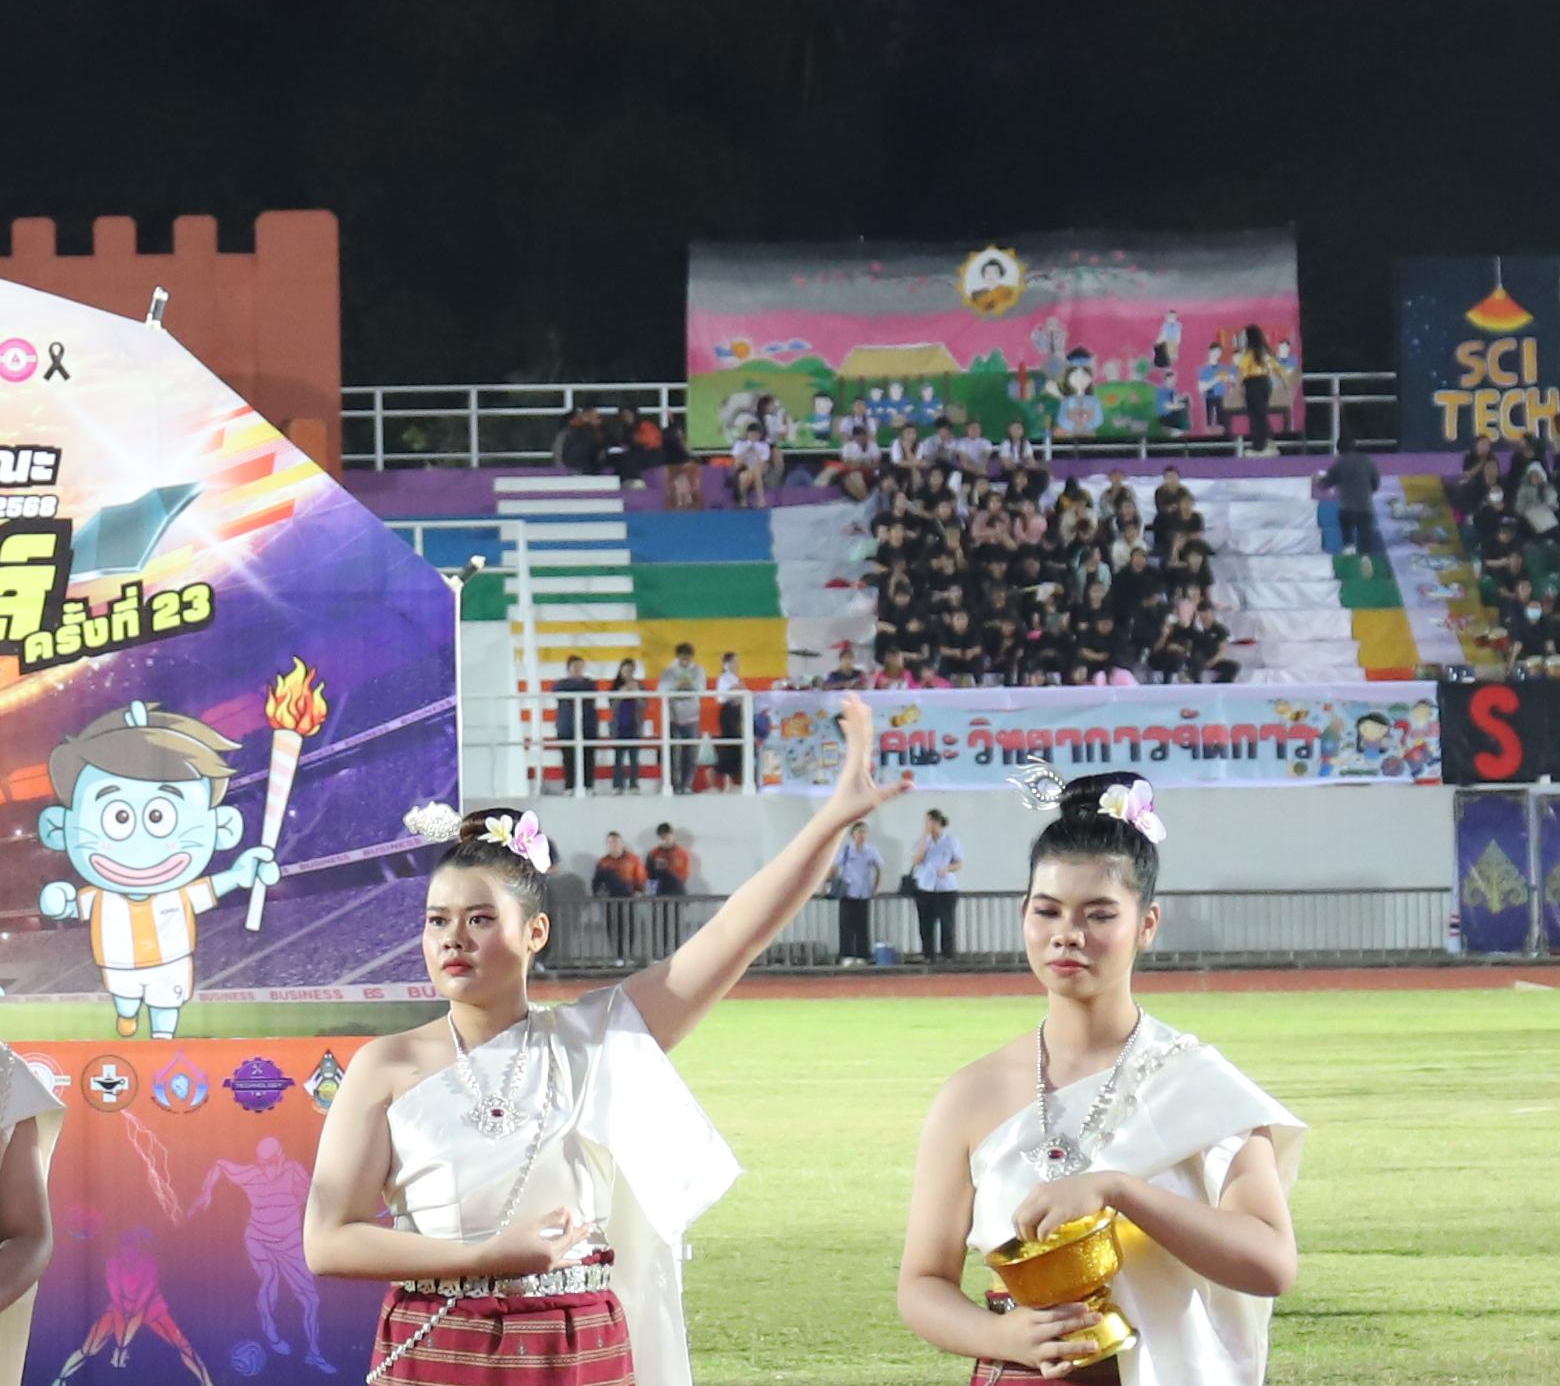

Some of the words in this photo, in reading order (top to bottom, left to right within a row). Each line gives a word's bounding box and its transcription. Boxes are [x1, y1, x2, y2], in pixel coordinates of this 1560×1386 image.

[1456, 338, 1540, 389] SCI
[1433, 387, 1560, 443] TECH
[24, 585, 142, 664] ครั้งที่
[151, 583, 212, 633] 23
[880, 726, 959, 766] คณะ
[270, 989, 344, 1001] BUSINESS
